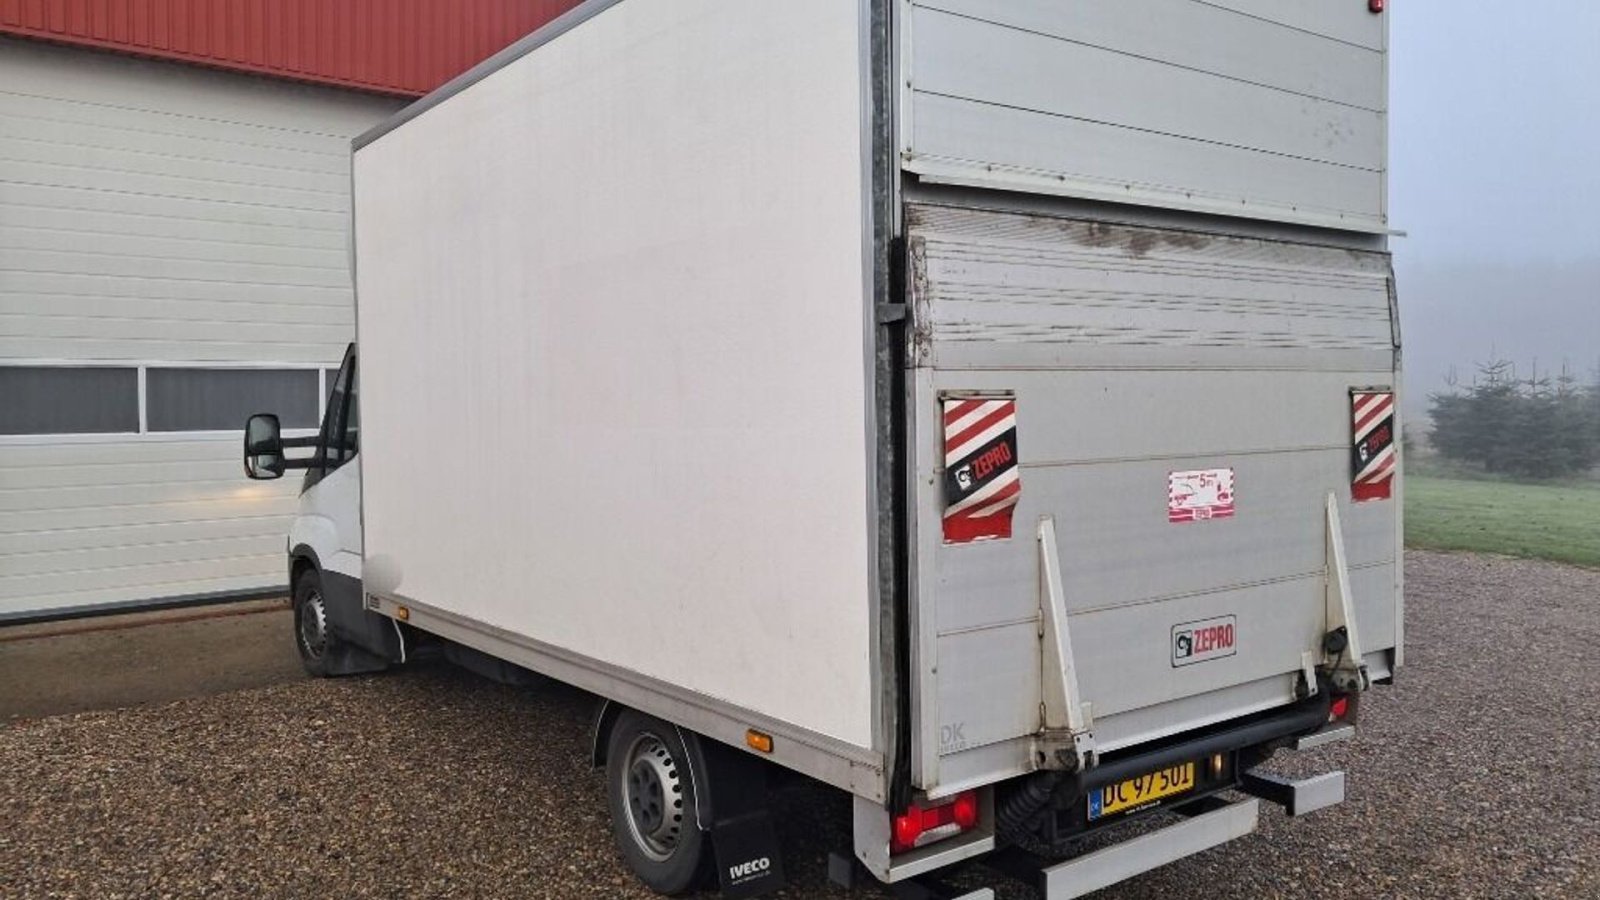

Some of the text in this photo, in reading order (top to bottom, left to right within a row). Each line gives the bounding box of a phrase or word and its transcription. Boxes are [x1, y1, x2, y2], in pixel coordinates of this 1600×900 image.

[971, 441, 1012, 480] ZEPRO
[1194, 623, 1233, 654] ZEPRO
[940, 722, 966, 745] DK
[1103, 780, 1128, 808] DC
[729, 857, 770, 879] IVECO
